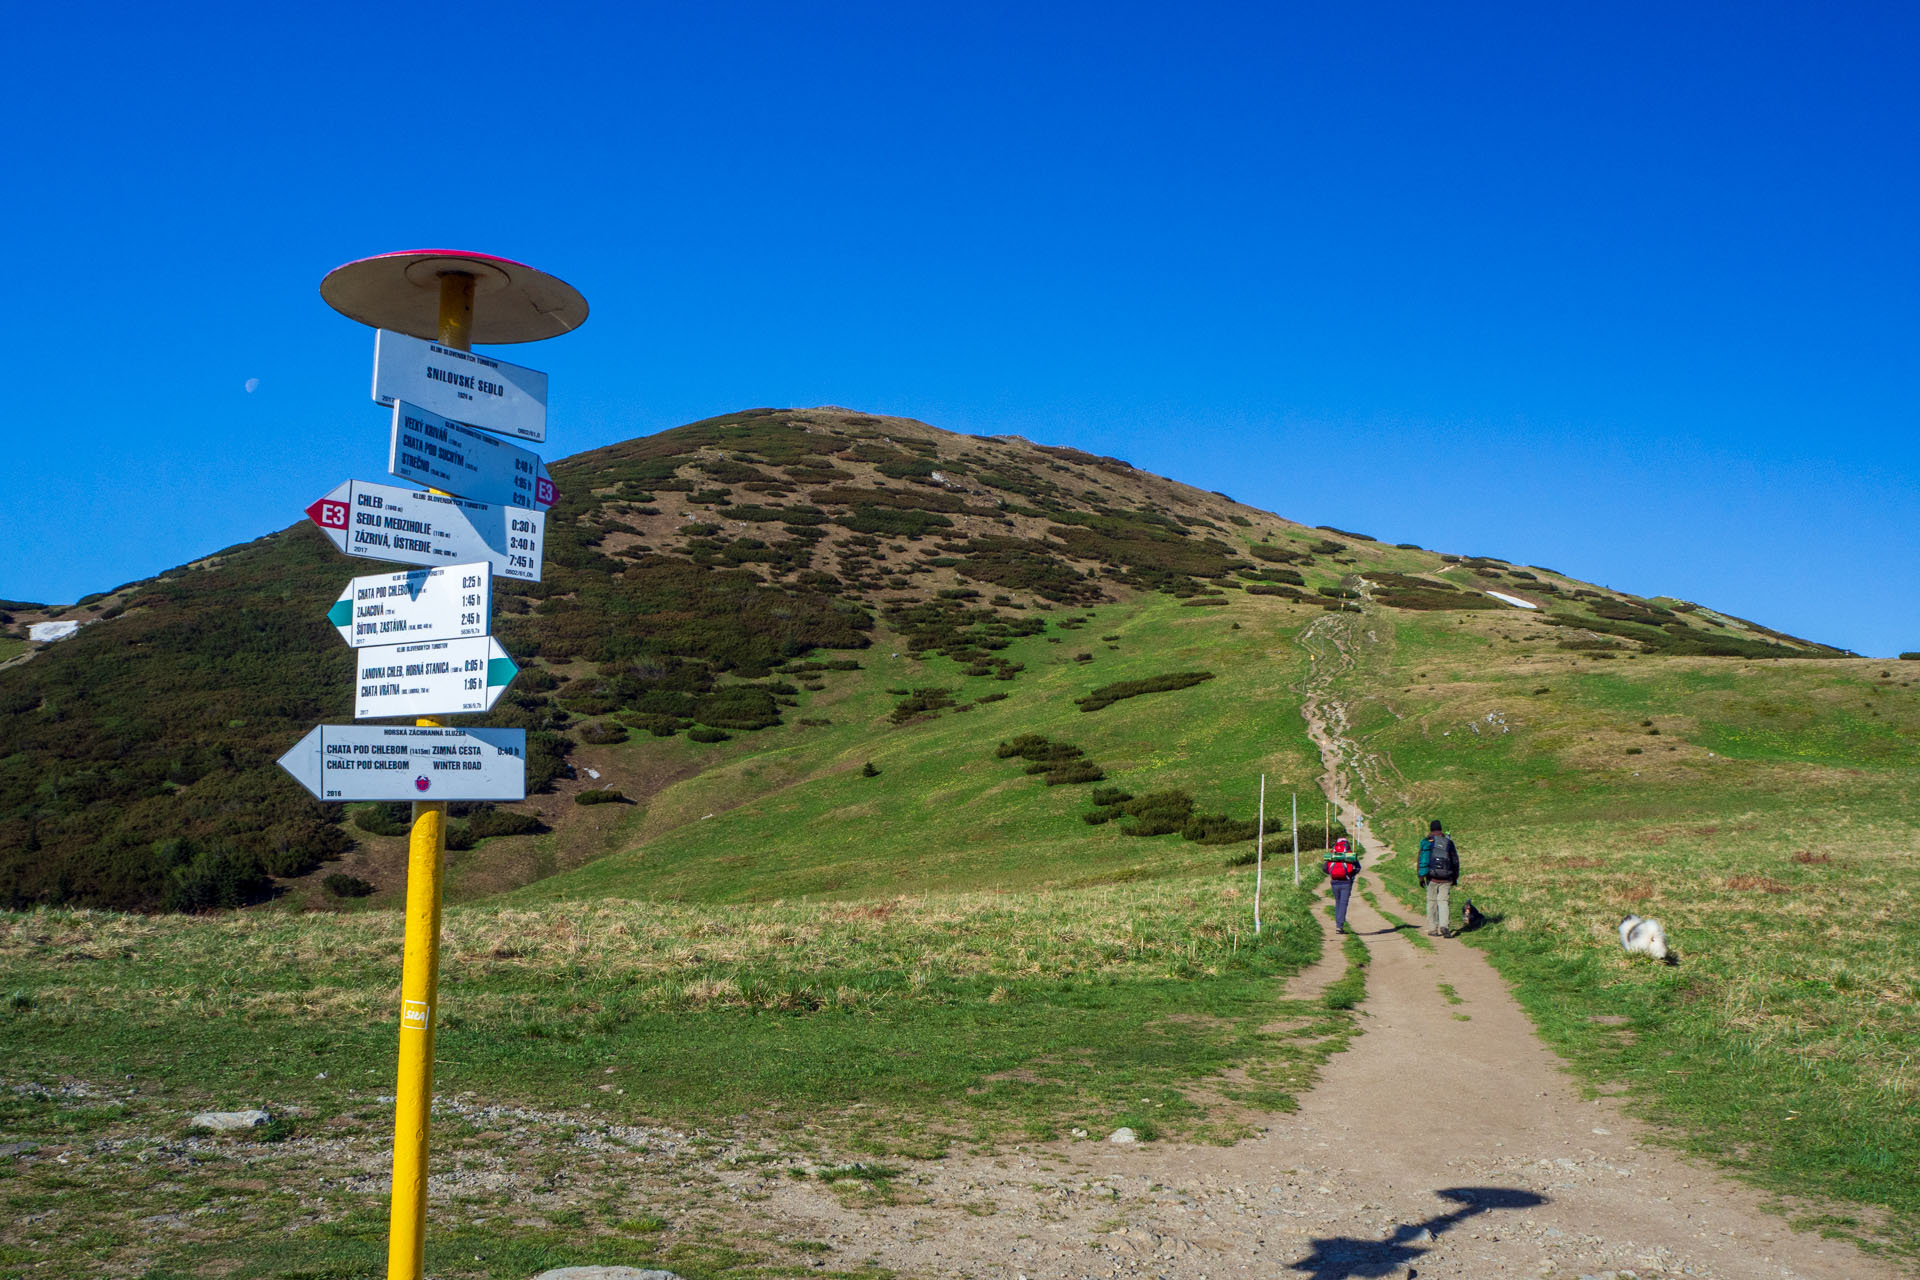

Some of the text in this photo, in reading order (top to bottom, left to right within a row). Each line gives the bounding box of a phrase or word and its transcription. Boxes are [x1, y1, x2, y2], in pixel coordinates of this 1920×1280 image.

[427, 366, 504, 396] SNILOVSKÉ SEDLO
[404, 434, 422, 452] CHATA
[425, 442, 436, 456] POD
[438, 446, 464, 467] SUCHÝM
[529, 464, 533, 474] h
[402, 453, 430, 472] STREČNO
[528, 480, 531, 491] h
[427, 495, 463, 506] SLOVENSKÝCH
[464, 501, 488, 510] TURISTOV
[527, 497, 530, 508] h
[539, 481, 552, 501] E3
[322, 504, 345, 525] E3
[358, 494, 383, 508] CHLEB
[512, 519, 529, 533] 0:30
[531, 522, 536, 534] h
[356, 512, 382, 527] SEDLO
[384, 516, 432, 535] MEDZIHOLIE
[511, 536, 528, 550] 3:40
[530, 540, 535, 551] h
[354, 529, 391, 549] ZÁZRIVÁ,
[394, 534, 432, 553] ÚSTREDIE
[510, 554, 527, 568] 7:45
[529, 557, 534, 569] h
[358, 588, 374, 600] CHATA
[376, 586, 387, 598] POD
[388, 583, 413, 597] CHLEBOM
[463, 576, 475, 588] 0:25
[477, 576, 481, 587] h
[357, 602, 384, 618] ZAJACOVÁ
[462, 594, 475, 607] 1:45
[477, 594, 481, 605] h
[356, 621, 378, 636] ŠÚTOVO,
[380, 618, 407, 633] ZASTÁVKA
[462, 612, 474, 625] 2:45
[476, 612, 480, 624] h
[362, 666, 385, 680] LANOVKA
[387, 665, 404, 678] CHLEB,
[406, 661, 424, 676] HORNÁ
[426, 662, 449, 675] STANICA
[465, 659, 478, 672] 0:05
[479, 659, 483, 671] h
[361, 685, 377, 697] CHATA
[379, 681, 400, 696] VRÁTNA
[464, 677, 477, 690] 1:05
[478, 677, 482, 690] h
[327, 745, 351, 754] CHATA
[354, 745, 369, 754] POD
[371, 745, 408, 755] CHLEBOM
[432, 744, 456, 755] ZIMNÁ
[459, 746, 481, 755] CESTA
[497, 747, 512, 756] 0:40
[514, 747, 519, 756] h
[327, 760, 482, 770] CHALET POD CHLEBOM WINTER ROAD
